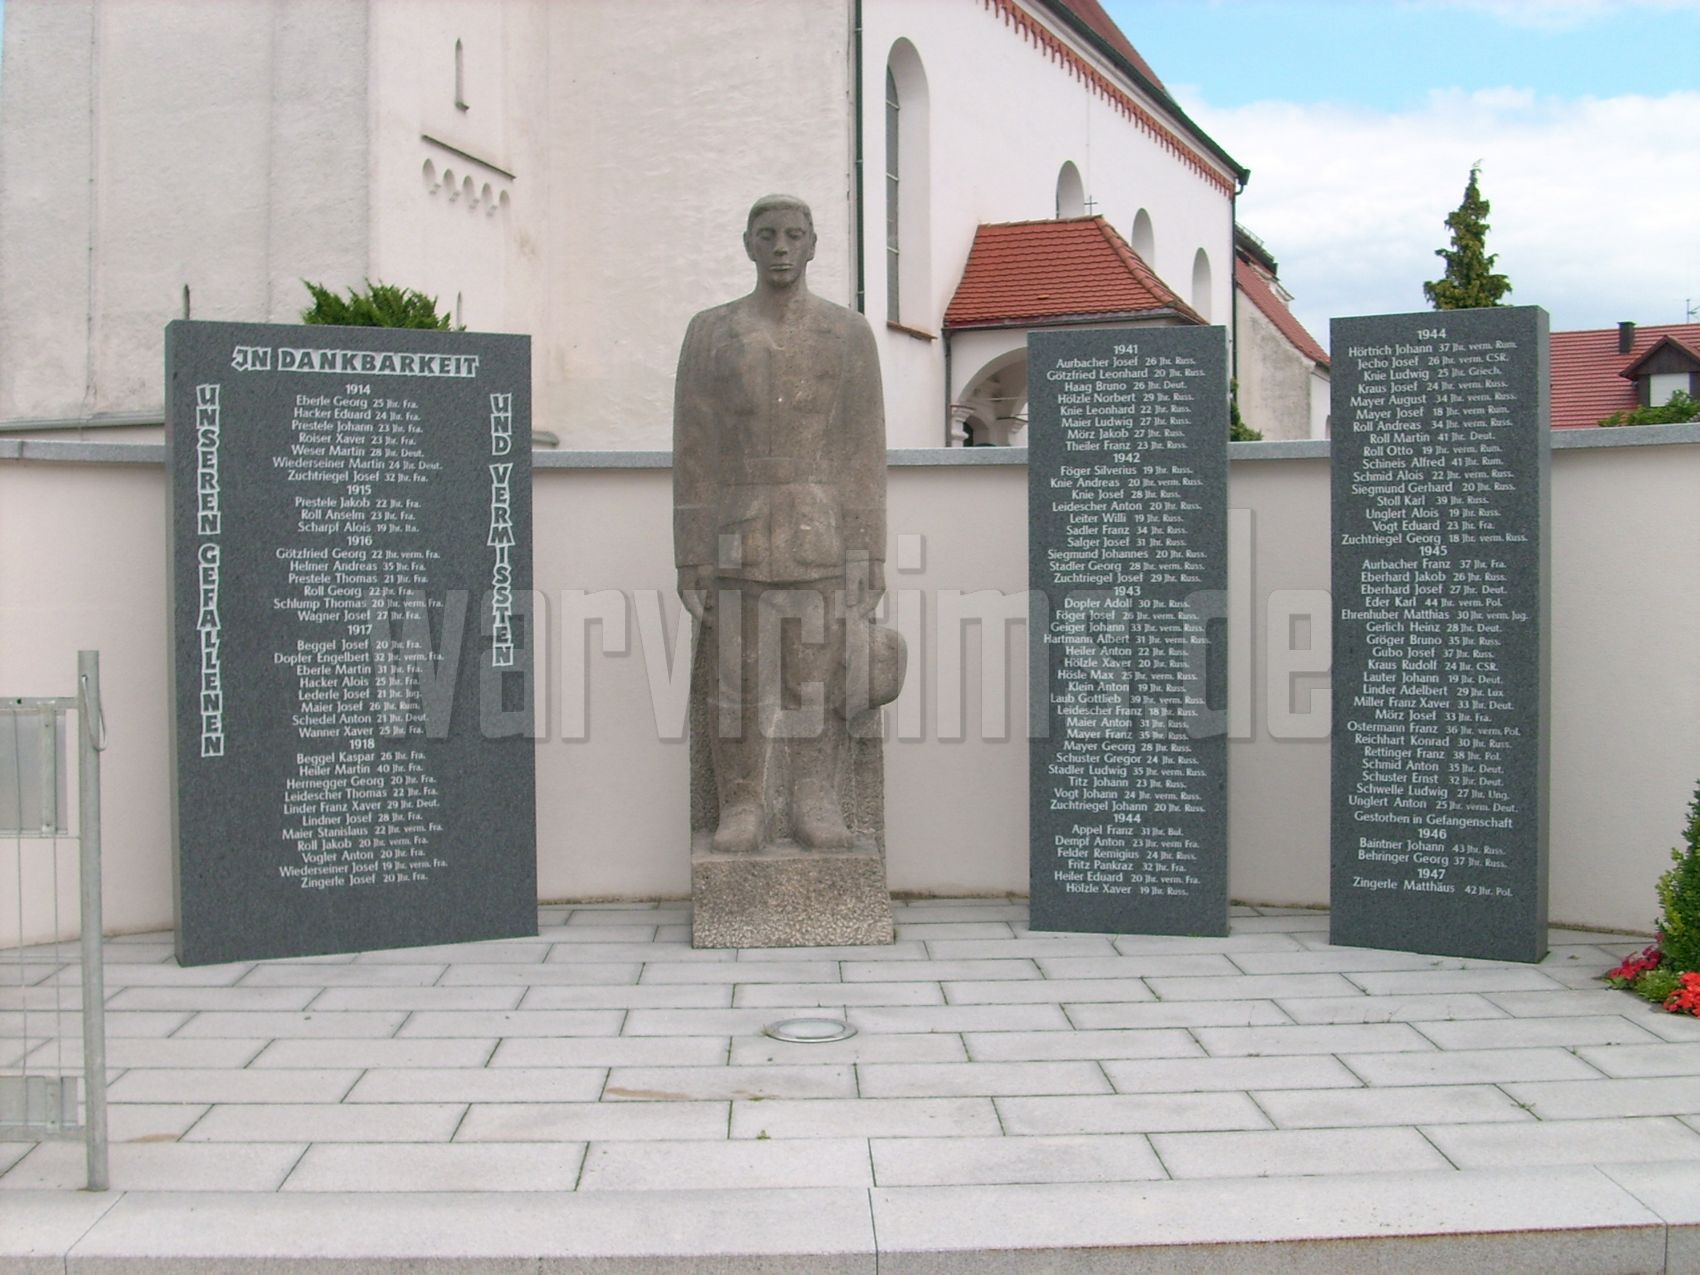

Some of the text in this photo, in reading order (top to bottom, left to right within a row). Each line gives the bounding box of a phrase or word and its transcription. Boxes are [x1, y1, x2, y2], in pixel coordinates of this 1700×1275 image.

[1417, 329, 1446, 339] 1944
[1114, 344, 1138, 354] 1941
[278, 348, 479, 377] DANKBARKEIT
[1056, 358, 1108, 368] Aurbacher
[1113, 357, 1138, 367] Josef
[1047, 369, 1148, 380] Götzfried Leonhard
[1364, 370, 1429, 381] Knie Ludwig
[345, 384, 371, 394] 1914
[1065, 382, 1092, 393] Haag
[1096, 382, 1126, 391] Bruno
[1133, 382, 1145, 390] 26
[296, 395, 330, 406] Eberle
[333, 396, 368, 409] Georg
[373, 399, 384, 407] 25
[294, 408, 371, 419] Hacker Eduard
[292, 420, 334, 431] Prestele
[337, 421, 373, 432] Johann
[378, 424, 390, 432] 23
[1062, 417, 1133, 429] Maier Ludwig
[1353, 420, 1421, 432] Roll Andreas
[1068, 430, 1128, 440] Mörz Jakob
[1370, 434, 1389, 444] Roll
[1393, 433, 1430, 443] Martin
[1437, 433, 1448, 441] 41
[292, 445, 365, 456] Weser Martin
[1364, 446, 1413, 457] Roll Otto
[273, 457, 385, 468] Wiederseiner Martin
[1113, 453, 1140, 462] 1942
[287, 470, 348, 483] Zuchtriegel
[353, 471, 379, 482] Josef
[385, 474, 396, 482] 32
[1051, 478, 1120, 488] Knie Andreas
[347, 485, 371, 495] 1915
[1352, 482, 1453, 496] Siegmund Gerhard
[1053, 501, 1142, 511] Leidescher Anton
[301, 510, 365, 519] Roll Anselm
[1070, 514, 1098, 523] Leiter
[1102, 513, 1126, 522] Willi
[487, 393, 515, 667] UND VERMISSTEN
[1066, 526, 1130, 535] Sadler Franz
[1372, 521, 1398, 534] Vogt
[1402, 521, 1440, 530] Eduard
[347, 536, 372, 546] 1916
[1341, 533, 1441, 546] Zuchtriegel Georg
[276, 548, 328, 559] Götzfried
[332, 549, 366, 562] Georg
[372, 551, 383, 559] 22
[1420, 546, 1447, 556] 1945
[196, 384, 224, 757] UNSEREN GEFALLENEN
[290, 561, 378, 571] Helmer Andreas
[1054, 573, 1143, 584] Zuchtriegel Josef
[1361, 571, 1446, 582] Eberhard Jakob
[1114, 586, 1141, 596] 1943
[1361, 584, 1443, 595] Eberhard Josef
[298, 610, 370, 623] Wagner Josef
[348, 625, 372, 635] 1917
[297, 640, 369, 653] Beggel Josef
[1363, 684, 1448, 695] Linder Adelbert
[350, 739, 375, 749] 1918
[1355, 734, 1449, 746] Reichhart Konrad
[1064, 741, 1098, 752] Mayer
[1102, 742, 1136, 753] Georg
[1141, 743, 1152, 751] 28
[297, 752, 374, 766] Beggel Kaspar
[300, 765, 330, 776] Heiler
[335, 764, 370, 774] Martin
[377, 764, 390, 772] 40
[1048, 764, 1127, 776] Stadler Ludwig
[285, 788, 387, 802] Leidescher Thomas
[1357, 783, 1448, 799] Schwelle Ludwig
[1114, 814, 1141, 823] 1944
[1355, 811, 1512, 828] Gestorben in Gefangenschaft
[282, 826, 368, 840] Maier Stanislaus
[1418, 829, 1447, 839] 1946
[298, 839, 352, 851] Roll Jakob
[1058, 848, 1139, 860] Felder Remigius
[1068, 860, 1133, 870] Fritz Pankraz
[1418, 868, 1446, 879] 1947
[301, 876, 345, 889] Zingerle
[350, 874, 375, 886] Josef
[384, 874, 395, 882] 20
[1353, 877, 1398, 890] Zingerle
[1404, 880, 1455, 893] Matthäus
[1465, 885, 1477, 894] 42
